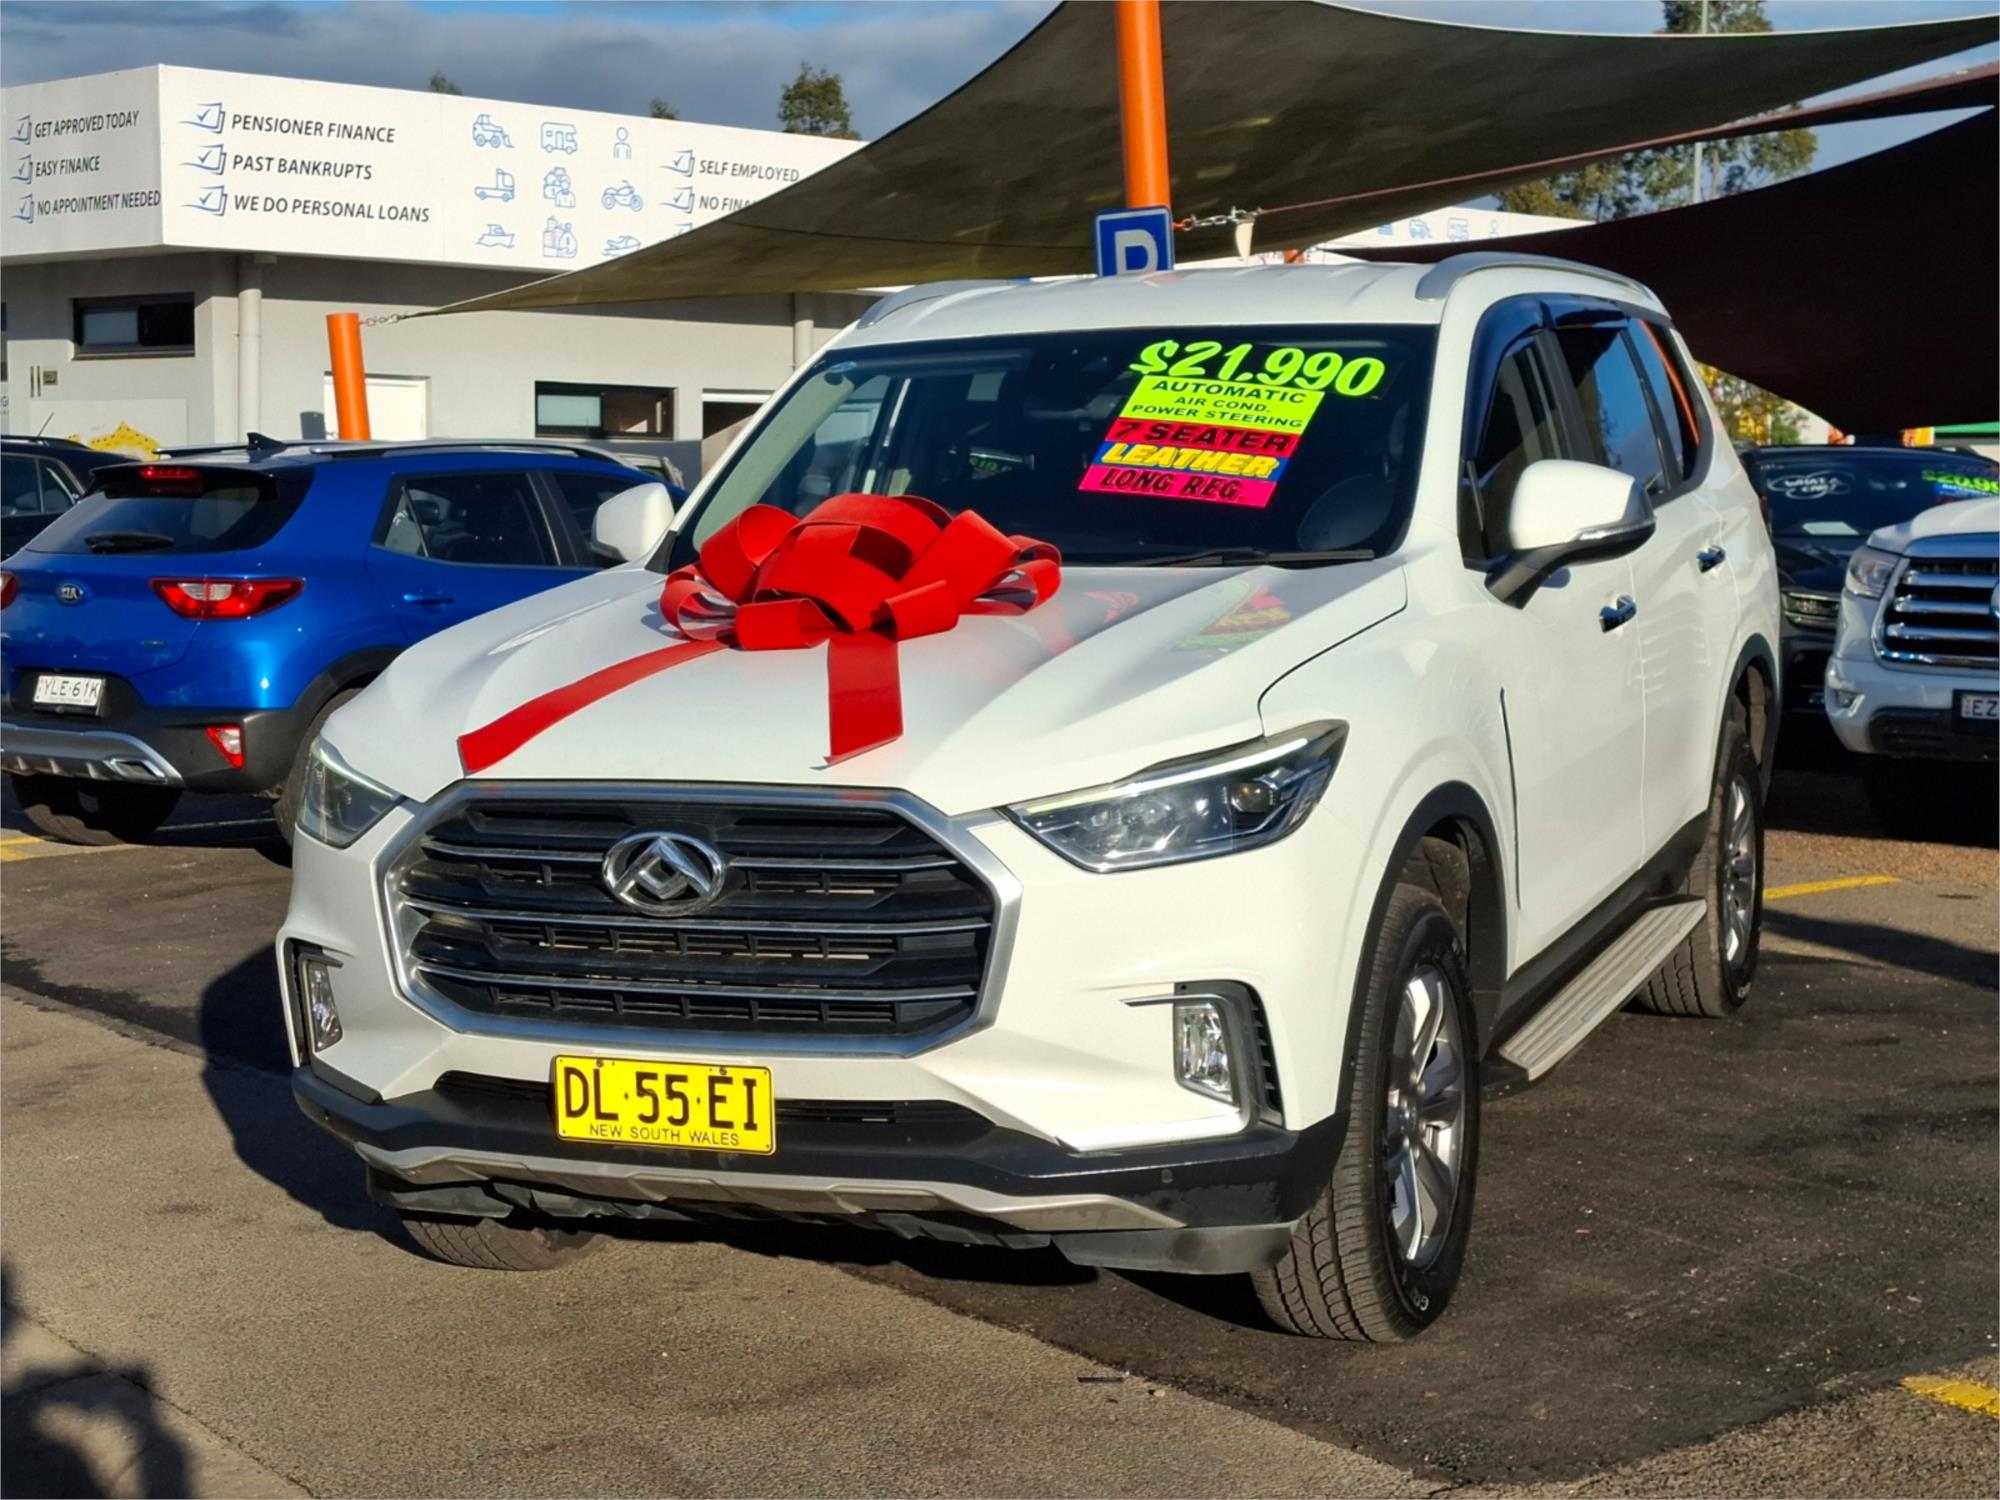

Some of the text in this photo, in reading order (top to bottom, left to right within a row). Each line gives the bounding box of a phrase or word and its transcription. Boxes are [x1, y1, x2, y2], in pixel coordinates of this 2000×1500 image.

[34, 110, 140, 138] GET APPROVED TODAY
[231, 113, 396, 143] PENSIONER FINANCE
[35, 155, 100, 177] EASY FINANCE
[232, 154, 373, 180] PAST BANKRUPTS
[699, 160, 800, 182] SELF EMPLOYED
[37, 190, 160, 216] NO APPOINTMENT NEEDED
[234, 194, 430, 223] WE DO PERSONAL LOANS
[699, 196, 757, 212] NO FINA
[1152, 380, 1307, 404] AUTOMATIC
[1175, 396, 1270, 413] AIR COND.
[1131, 404, 1304, 429] POWER STEERING
[1109, 421, 1293, 453] 7 SEATER
[1101, 443, 1281, 478] LEATHER
[1100, 469, 1247, 500] LONG REG.
[589, 1122, 741, 1147] NEW SOUTH WALES
